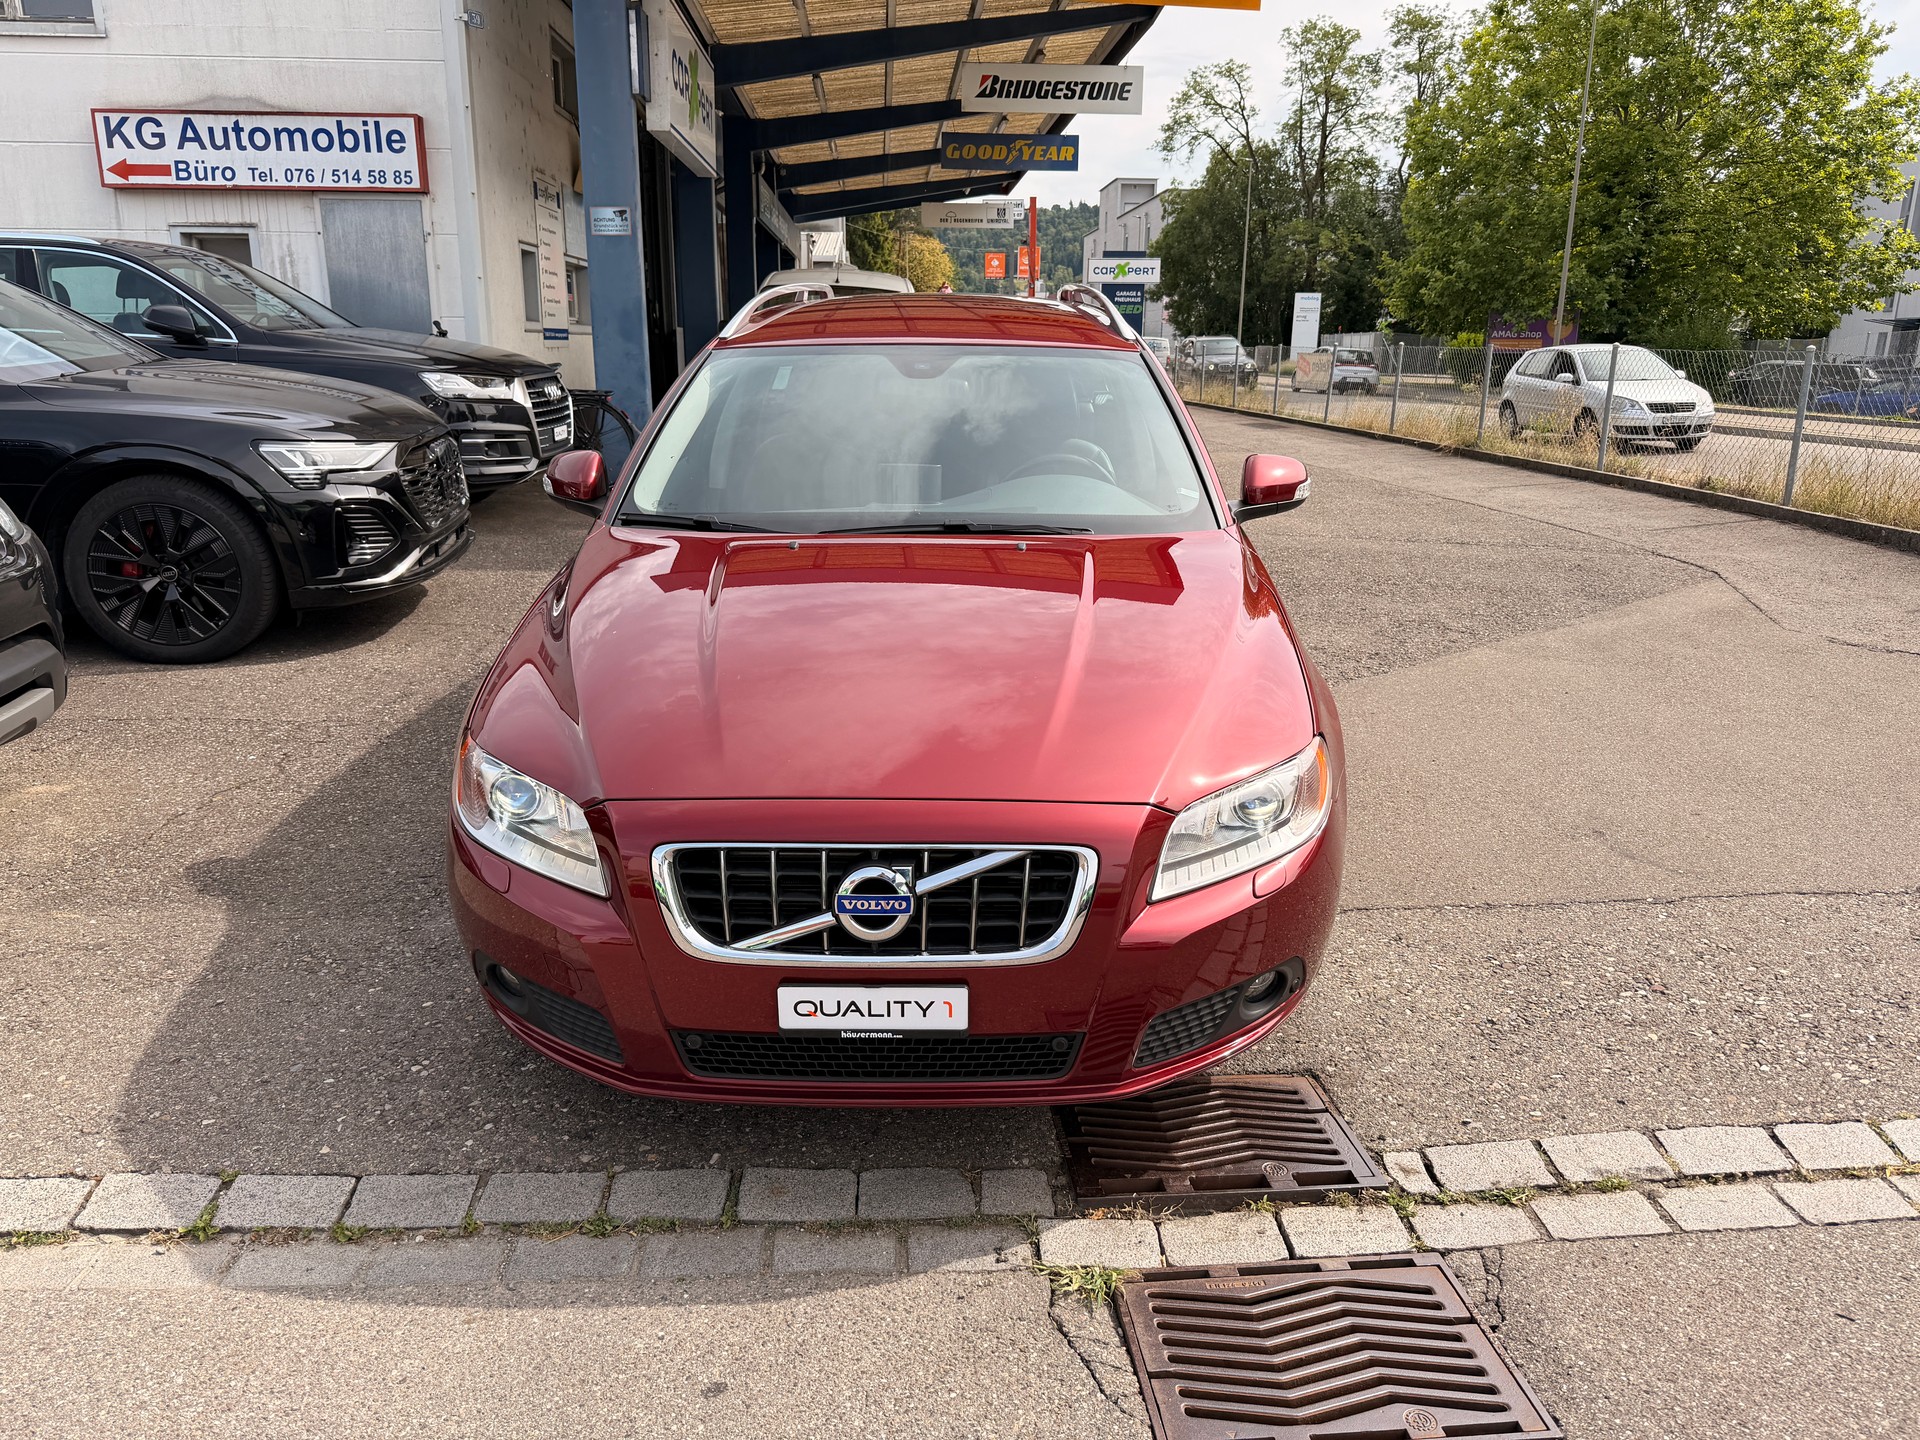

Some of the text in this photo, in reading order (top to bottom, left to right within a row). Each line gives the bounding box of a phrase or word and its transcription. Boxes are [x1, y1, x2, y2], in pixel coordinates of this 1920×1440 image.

[975, 74, 1133, 102] BRIDGESTONE
[103, 115, 407, 154] KG Automobile
[174, 160, 236, 182] Büro
[248, 167, 279, 183] Tel.
[284, 168, 315, 183] 076
[331, 169, 362, 184] 514
[367, 169, 387, 185] 58
[393, 170, 414, 185] 85
[1491, 330, 1542, 339] AMAG Shop
[840, 899, 908, 911] VOLVO
[793, 1000, 953, 1018] QUALITY 1
